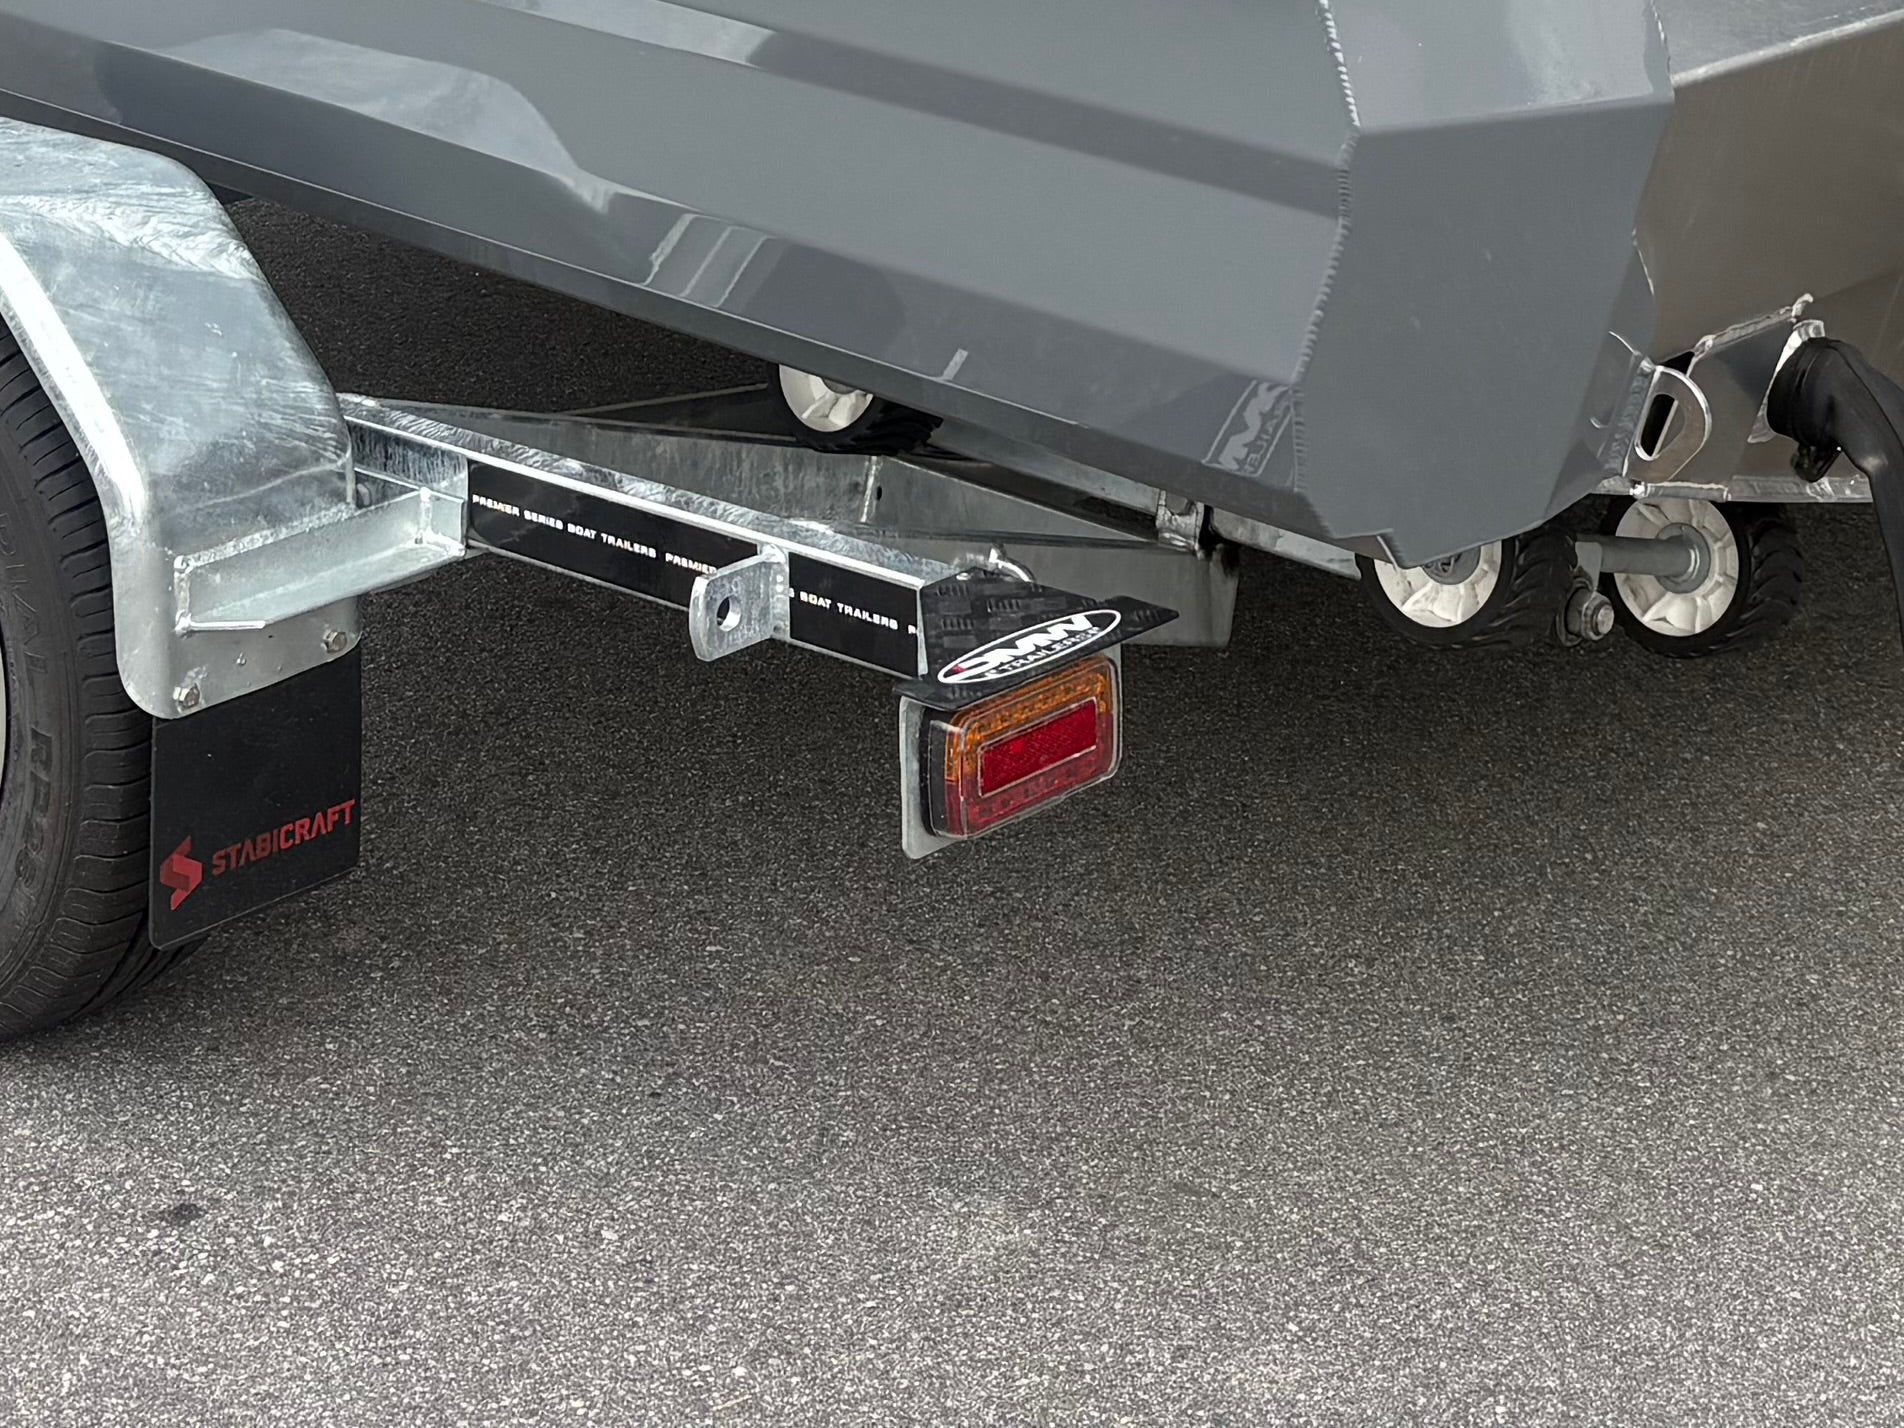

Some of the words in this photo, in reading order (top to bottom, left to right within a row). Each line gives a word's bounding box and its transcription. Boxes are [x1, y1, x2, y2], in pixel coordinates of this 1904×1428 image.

[472, 494, 520, 517] PREMIER
[524, 508, 564, 530] SERIES
[567, 522, 597, 540] BOAT
[601, 532, 657, 559] TRAILERS
[799, 591, 833, 610] BOAT
[837, 602, 898, 631] TRAILERS
[211, 799, 356, 876] STABICRAFT
